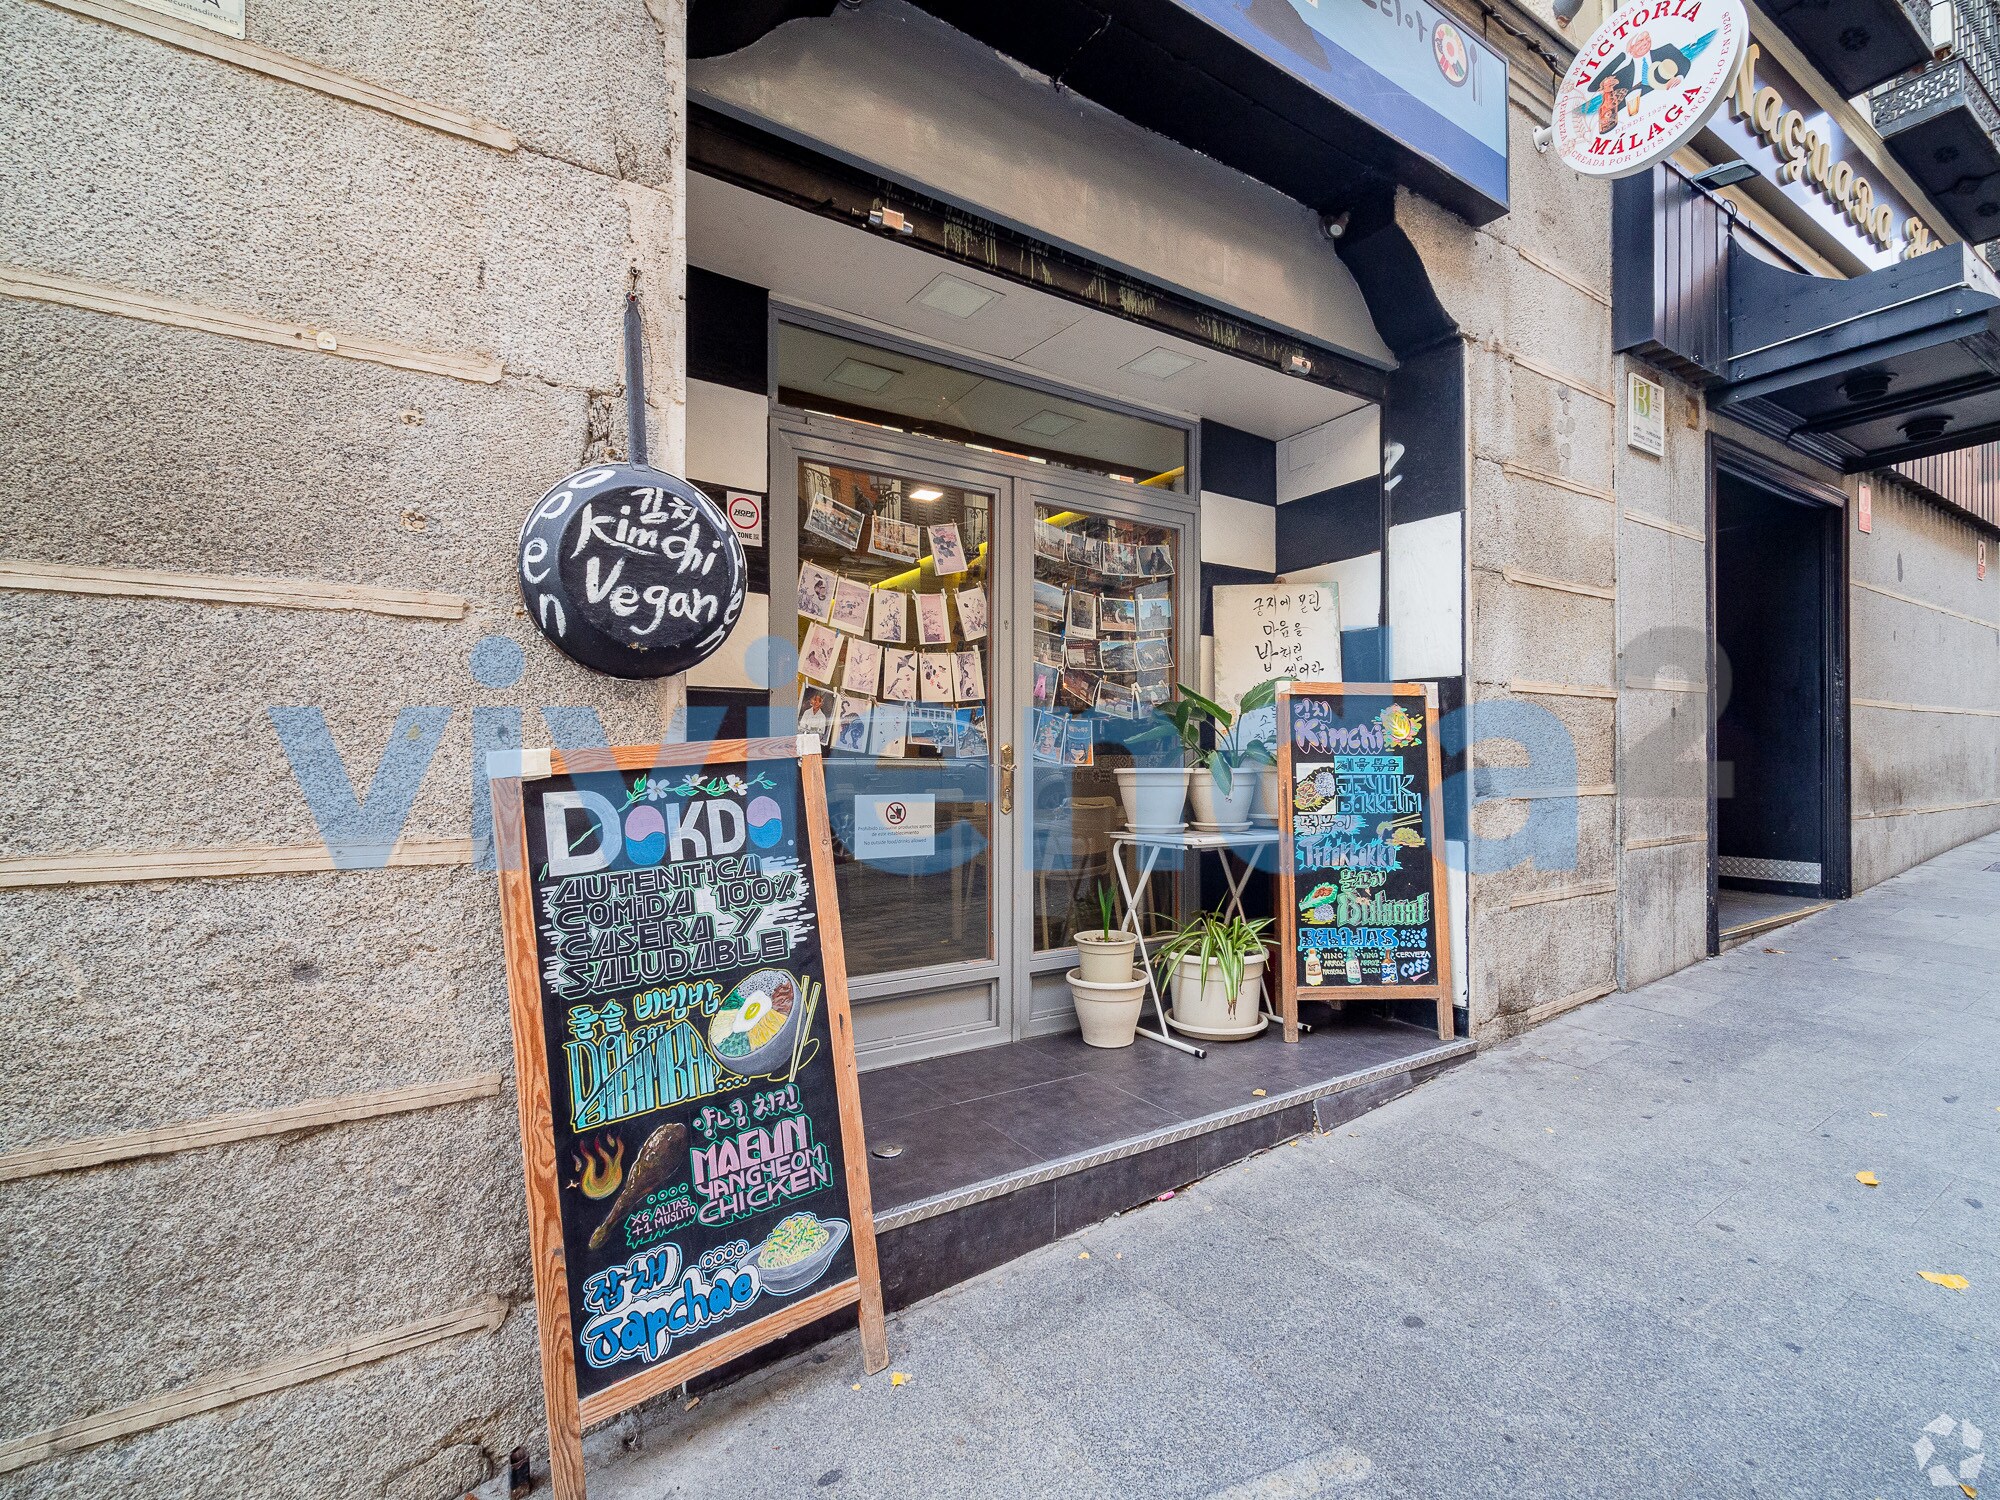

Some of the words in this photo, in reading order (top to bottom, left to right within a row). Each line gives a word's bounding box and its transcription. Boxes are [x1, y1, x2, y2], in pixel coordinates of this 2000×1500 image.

[167, 0, 239, 26] ecuritasdirect.es
[1721, 11, 1732, 35] 1928
[1575, 0, 1702, 88] VICTORIA
[1720, 38, 1731, 56] EN
[1588, 85, 1702, 155] MÁLAGA
[1571, 150, 1606, 167] CREADA
[1608, 153, 1632, 166] POR
[1635, 136, 1664, 157] LUIS
[630, 486, 700, 531] 김치
[570, 502, 724, 576] Kimchi
[586, 556, 719, 635] Vegan
[1294, 719, 1384, 753] Kimchi
[714, 872, 797, 908] 100%
[557, 915, 714, 962] CASERA
[730, 905, 764, 937] Y
[560, 929, 789, 997] SALUDABLE
[1322, 952, 1343, 960] VINO
[1361, 952, 1379, 960] VINO
[1395, 950, 1432, 959] CERVEZA
[634, 981, 721, 1022] 비빔밥
[754, 1084, 800, 1119] 치킨
[691, 1115, 808, 1186] MAEUN
[654, 1196, 690, 1217] ALITAS
[698, 1163, 830, 1224] CHICKEN
[632, 1221, 653, 1236] +1
[653, 1205, 697, 1229] MUSLITO
[590, 1252, 668, 1308] 잡채
[590, 1271, 753, 1359] Japchae
